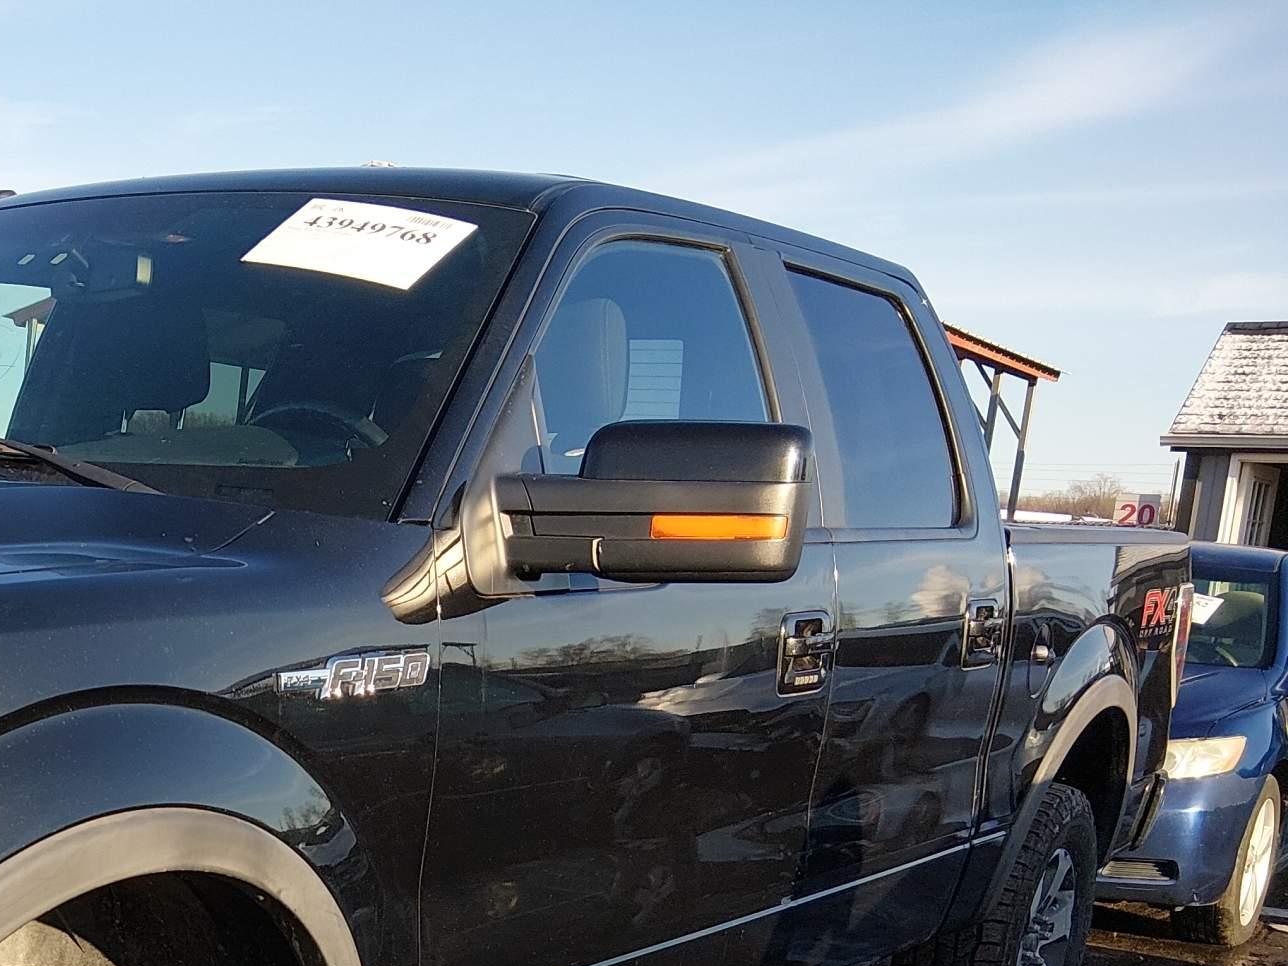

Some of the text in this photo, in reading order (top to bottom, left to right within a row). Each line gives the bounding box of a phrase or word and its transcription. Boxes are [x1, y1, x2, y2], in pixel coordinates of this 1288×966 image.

[304, 215, 438, 245] 43949768
[1118, 503, 1155, 526] 20
[1141, 586, 1178, 628] FX4
